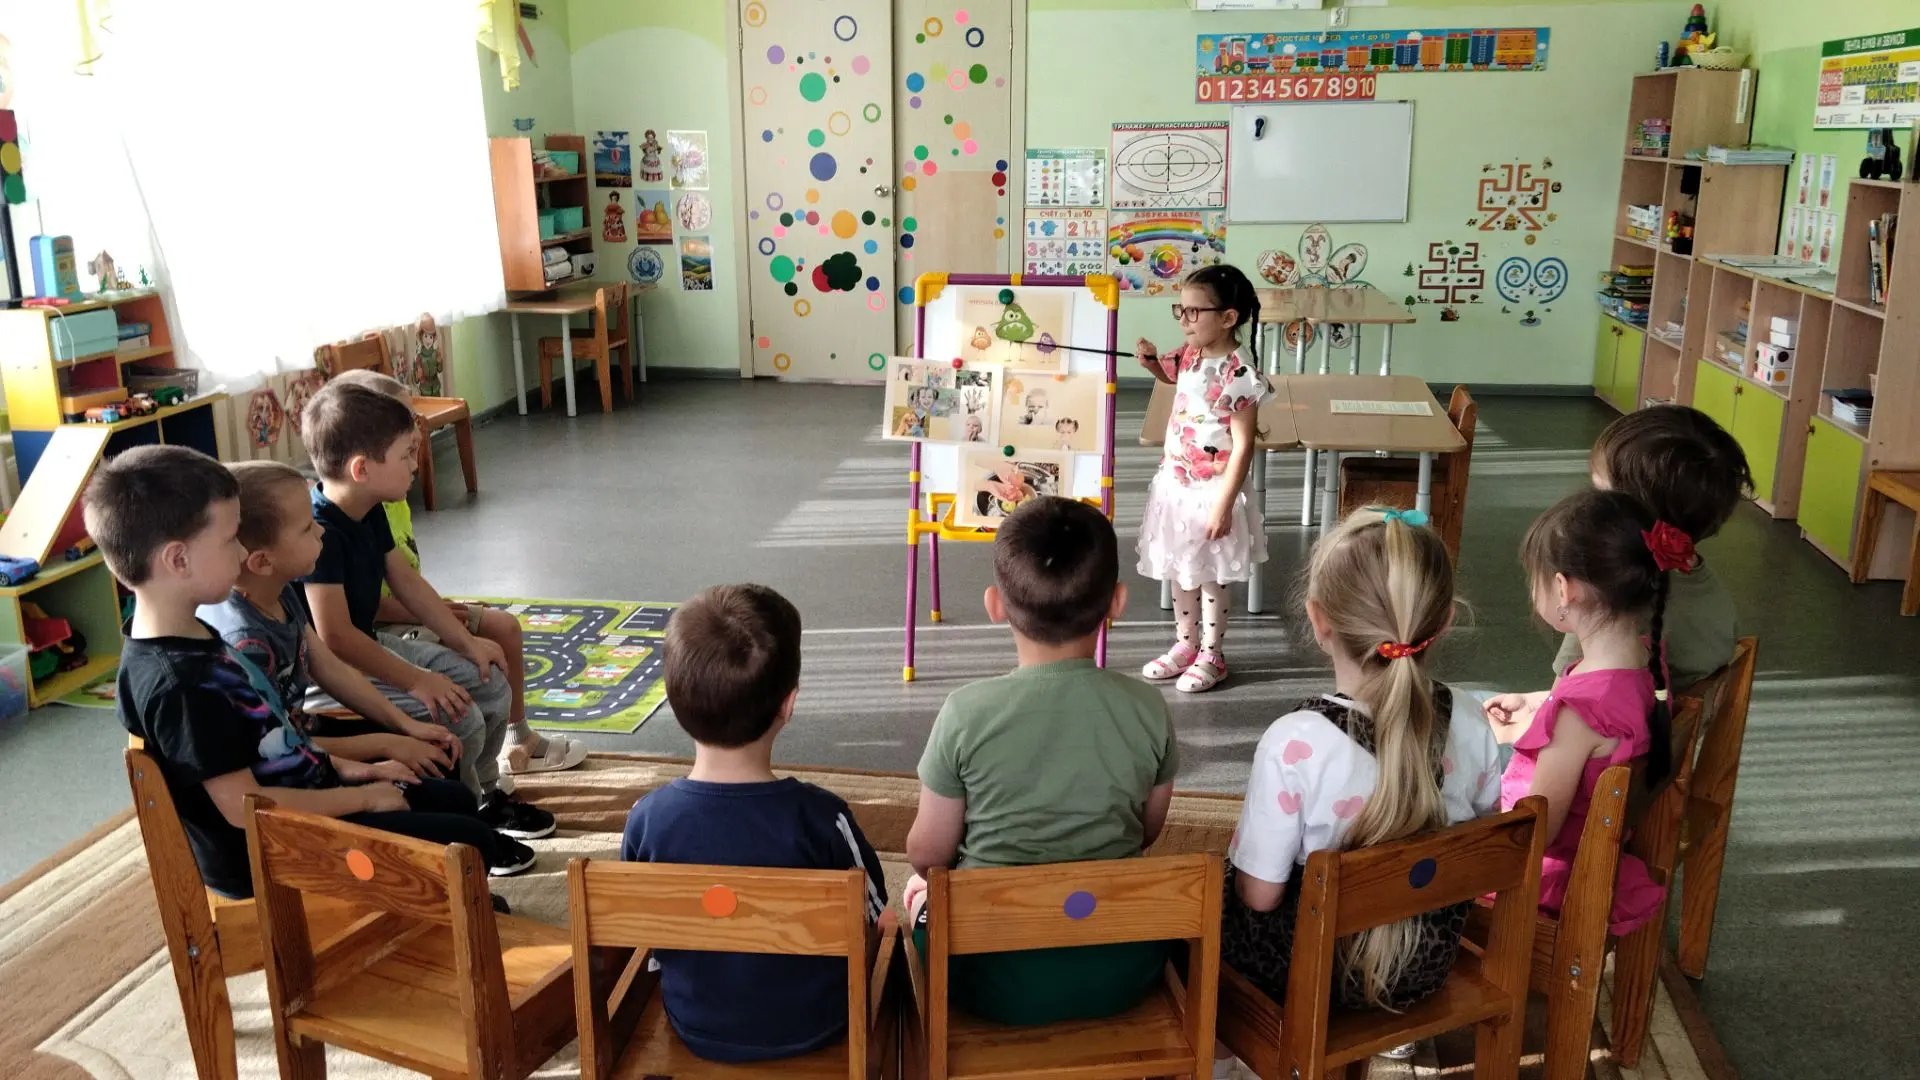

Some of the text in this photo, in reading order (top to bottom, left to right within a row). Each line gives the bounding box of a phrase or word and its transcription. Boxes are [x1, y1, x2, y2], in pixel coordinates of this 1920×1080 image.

[1198, 77, 1375, 99] 0 1 2 3 4 5 6 7 8 9 10
[1067, 210, 1072, 218] 1
[1083, 210, 1092, 218] 10
[1028, 221, 1036, 235] 1
[1068, 221, 1078, 236] 2
[1028, 242, 1037, 256] 3
[1067, 242, 1078, 256] 4
[1027, 262, 1037, 275] 5
[1067, 262, 1078, 275] 6
